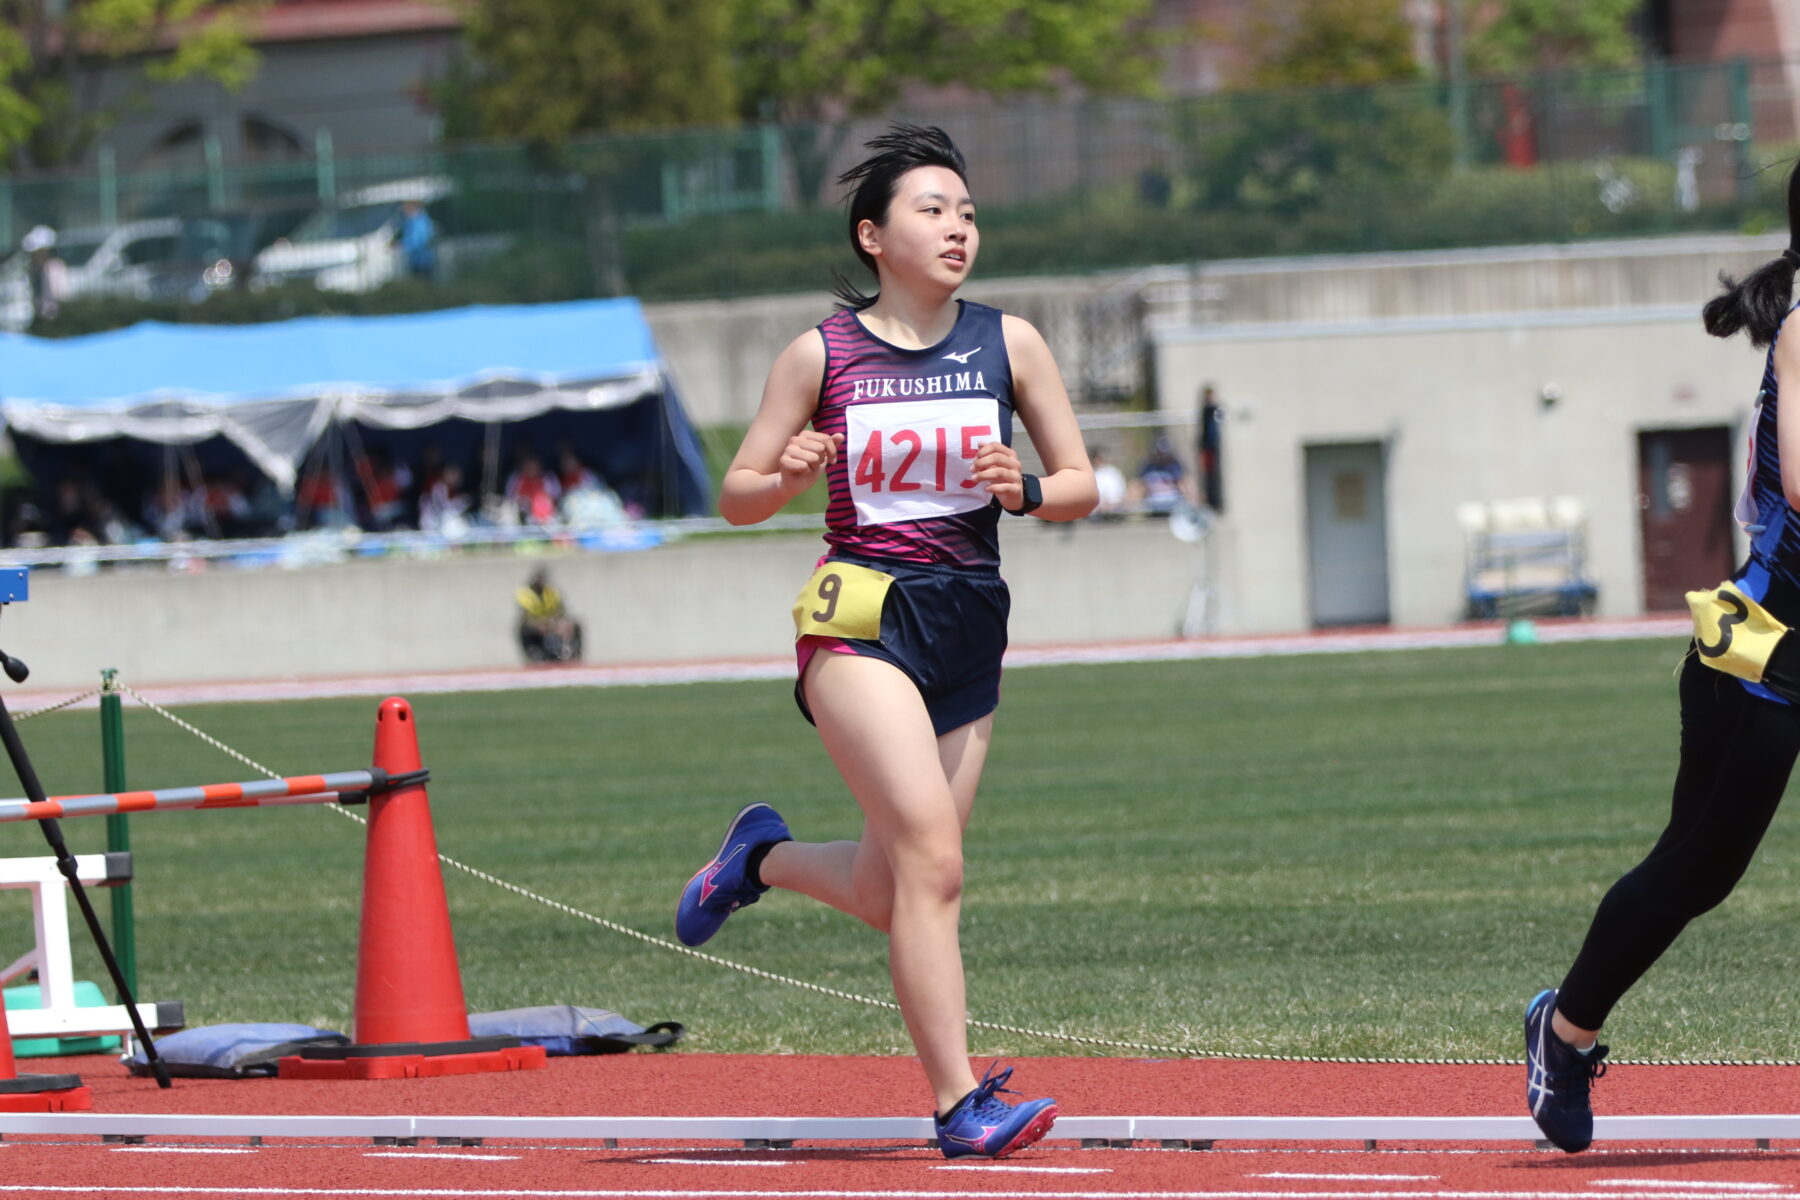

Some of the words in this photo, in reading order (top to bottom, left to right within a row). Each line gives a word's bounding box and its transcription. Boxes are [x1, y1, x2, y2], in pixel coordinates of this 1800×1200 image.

[852, 370, 988, 401] FUKUSHIMA
[854, 424, 992, 494] 4215
[811, 572, 843, 623] 9
[1699, 589, 1749, 658] 3
